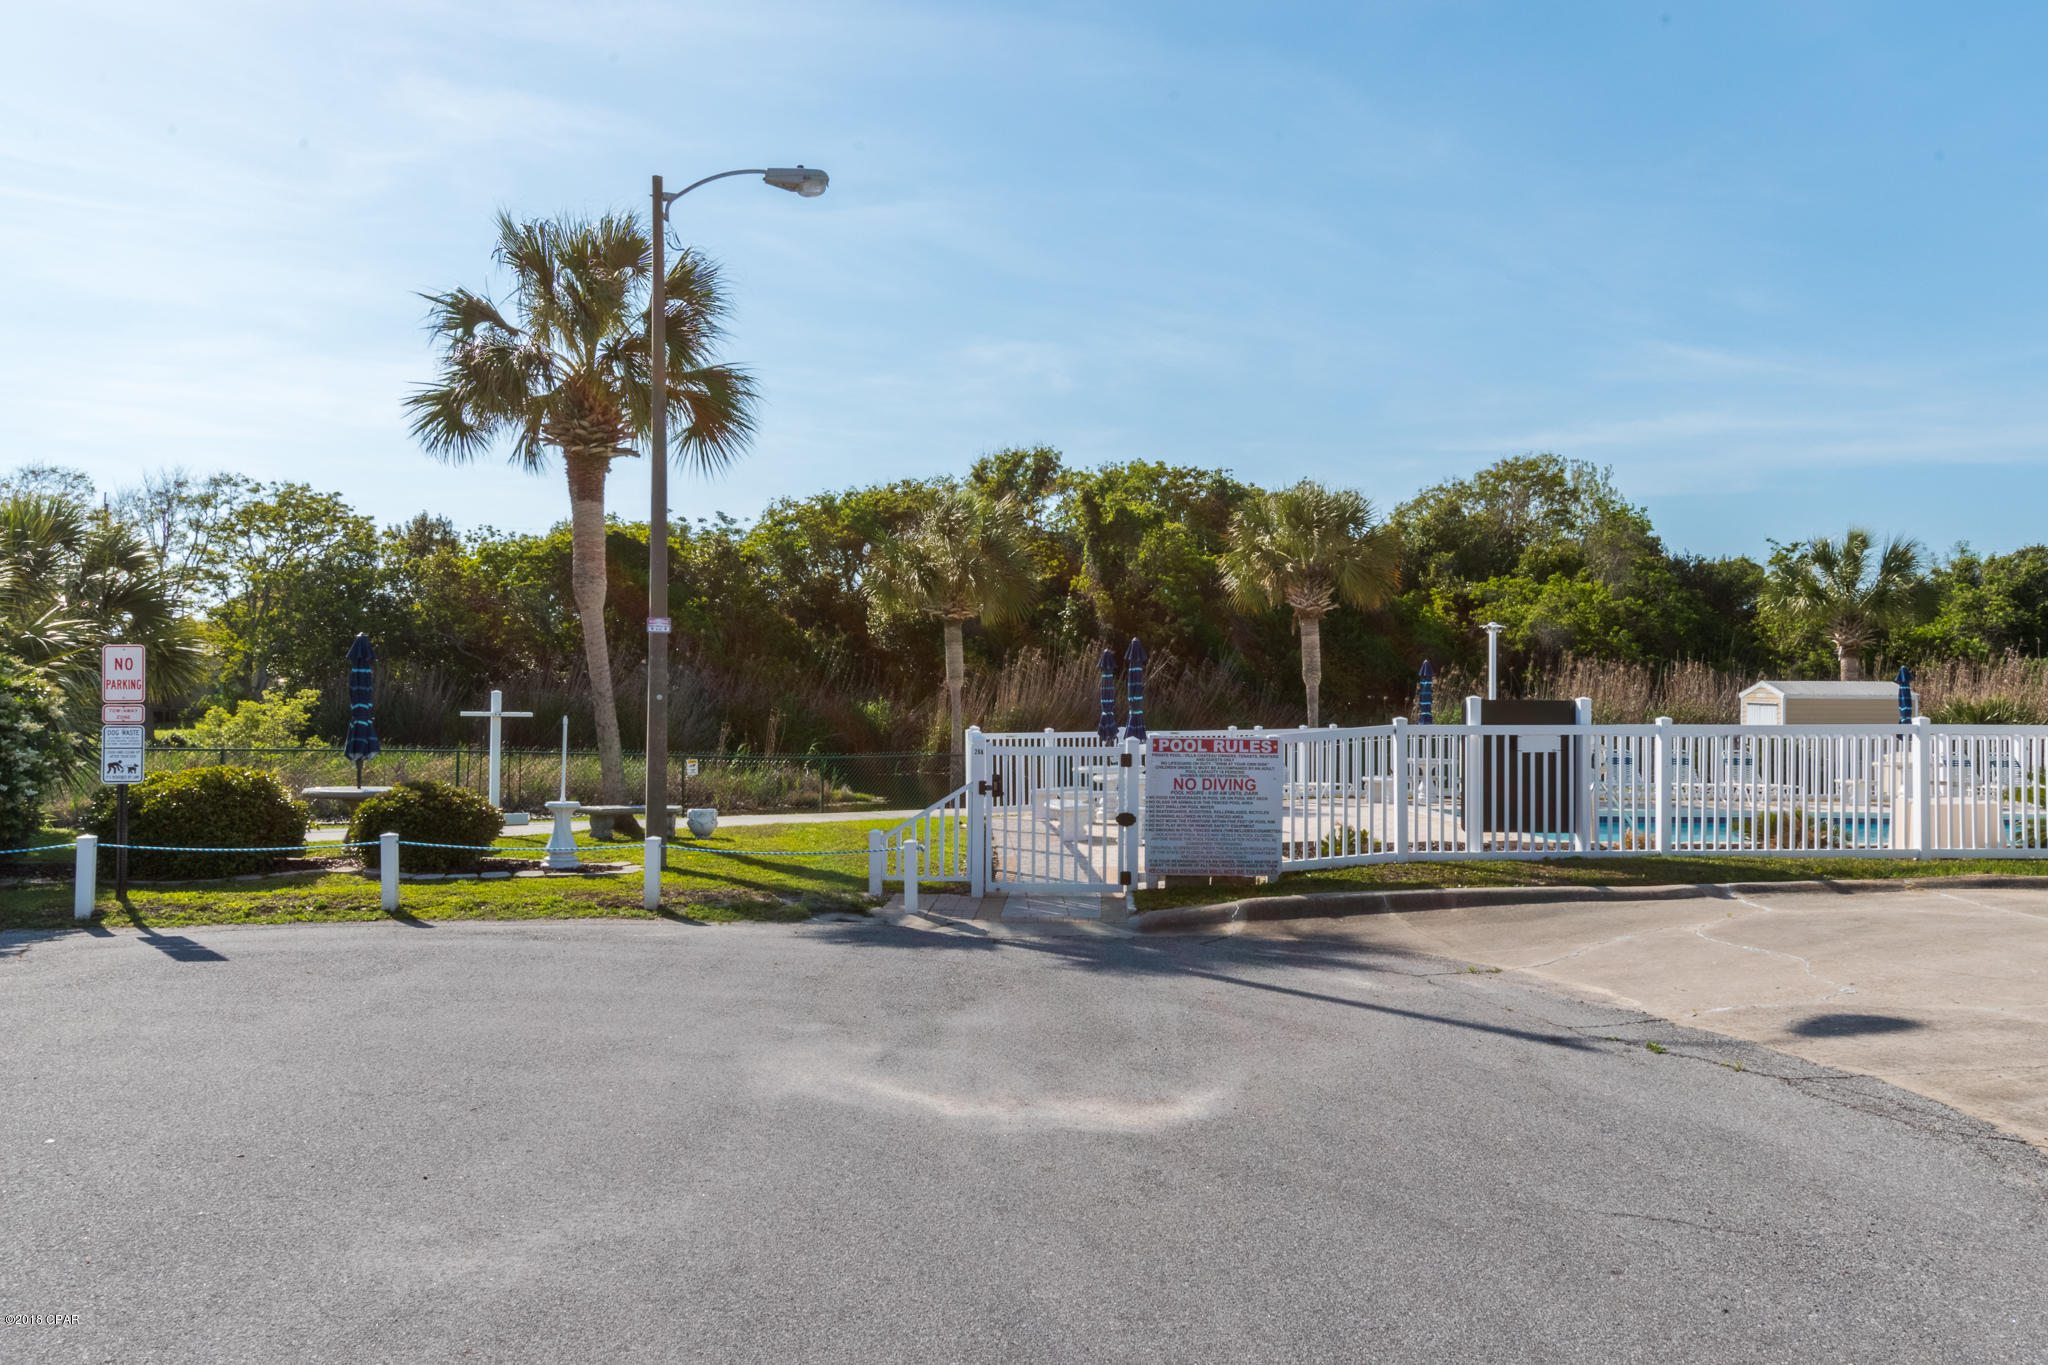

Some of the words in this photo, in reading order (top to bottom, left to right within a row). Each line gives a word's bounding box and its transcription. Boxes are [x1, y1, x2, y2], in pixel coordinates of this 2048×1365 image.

[114, 658, 133, 670] NO
[106, 680, 141, 689] PARKING
[1159, 740, 1208, 752] POOL
[1214, 740, 1272, 752] RULES
[1173, 778, 1197, 790] NO
[1202, 778, 1256, 791] DIVING
